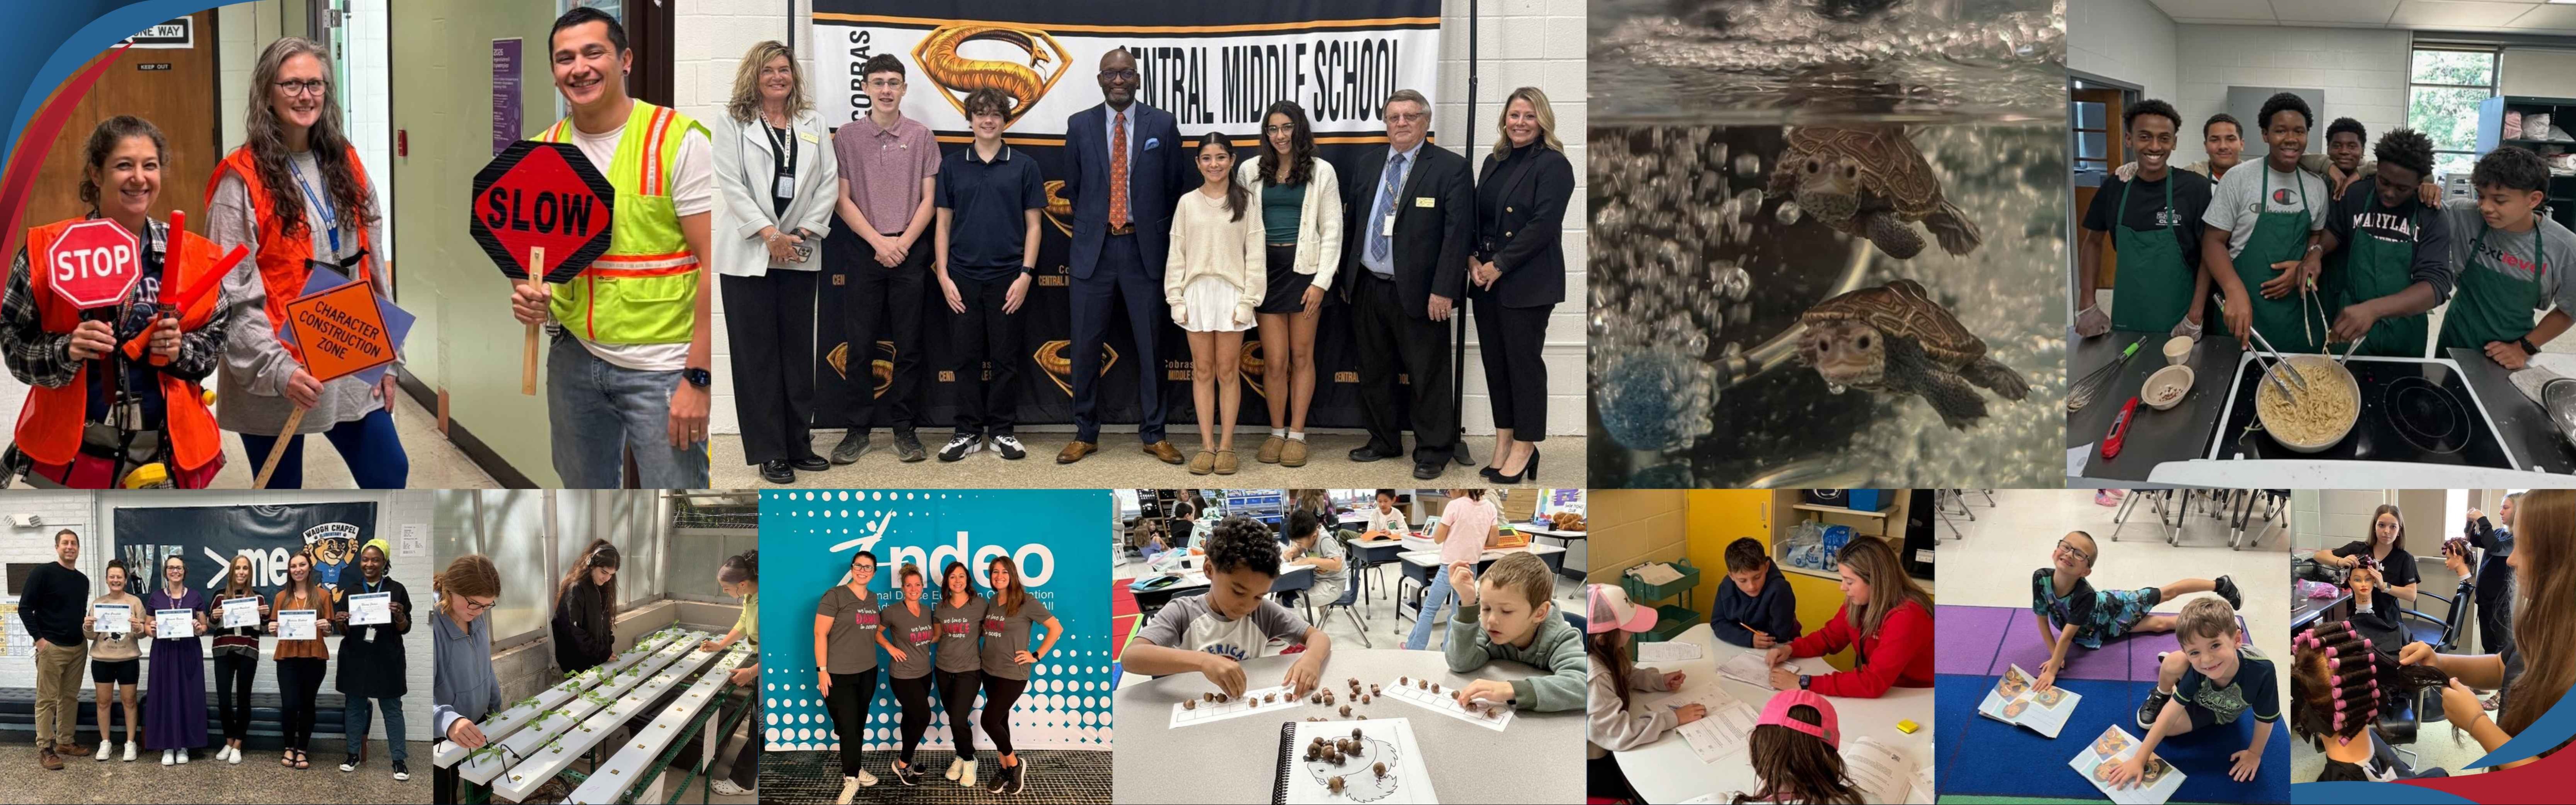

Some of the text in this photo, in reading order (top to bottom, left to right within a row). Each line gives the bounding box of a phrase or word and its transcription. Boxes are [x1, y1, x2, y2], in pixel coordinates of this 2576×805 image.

[134, 26, 180, 36] NE WAY
[1314, 39, 1397, 122] SCHOOL
[487, 187, 593, 237] SLOW
[57, 245, 130, 281] STOP
[299, 310, 381, 358] CONSTRUCTION
[315, 301, 380, 340] CHARACTER
[317, 337, 349, 360] ZONE
[305, 525, 356, 538] WAUGH CHAPEL
